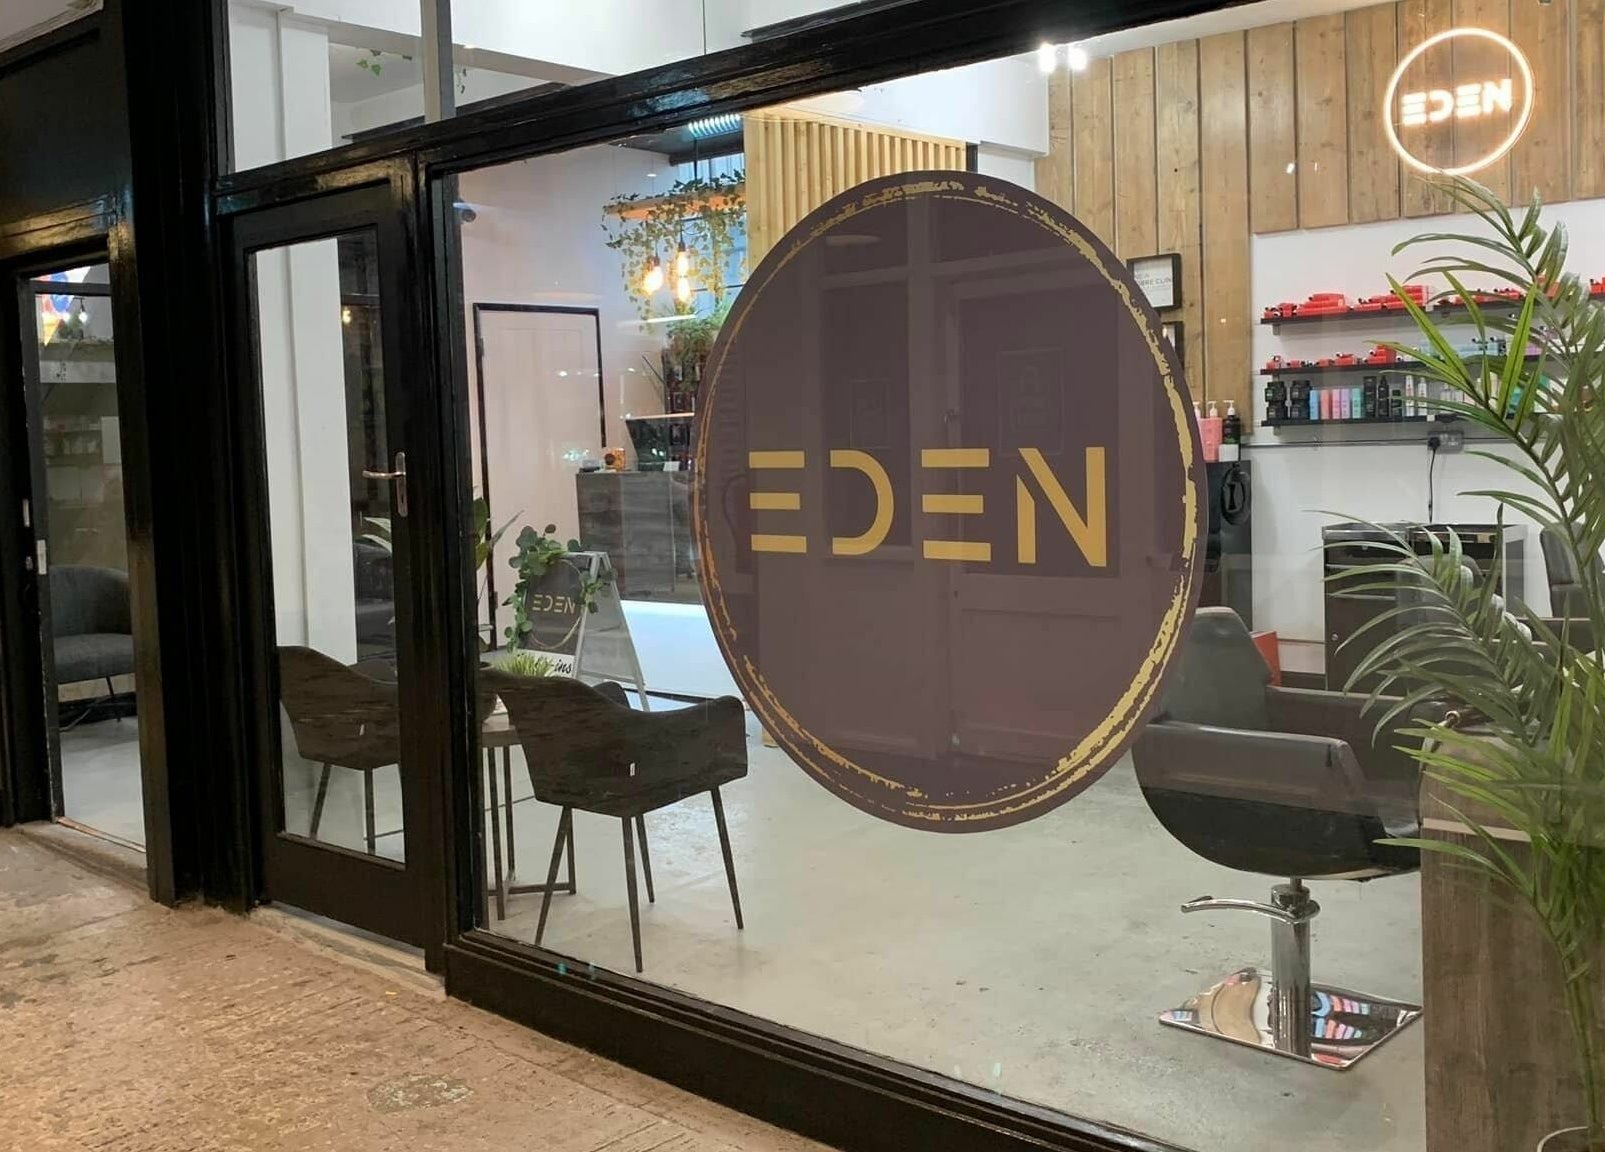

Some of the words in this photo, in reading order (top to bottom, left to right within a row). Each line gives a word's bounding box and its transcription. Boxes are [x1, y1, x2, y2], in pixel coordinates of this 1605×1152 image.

[1401, 78, 1512, 127] EDEN
[748, 446, 1107, 567] EDEN
[532, 594, 576, 614] EDEN
